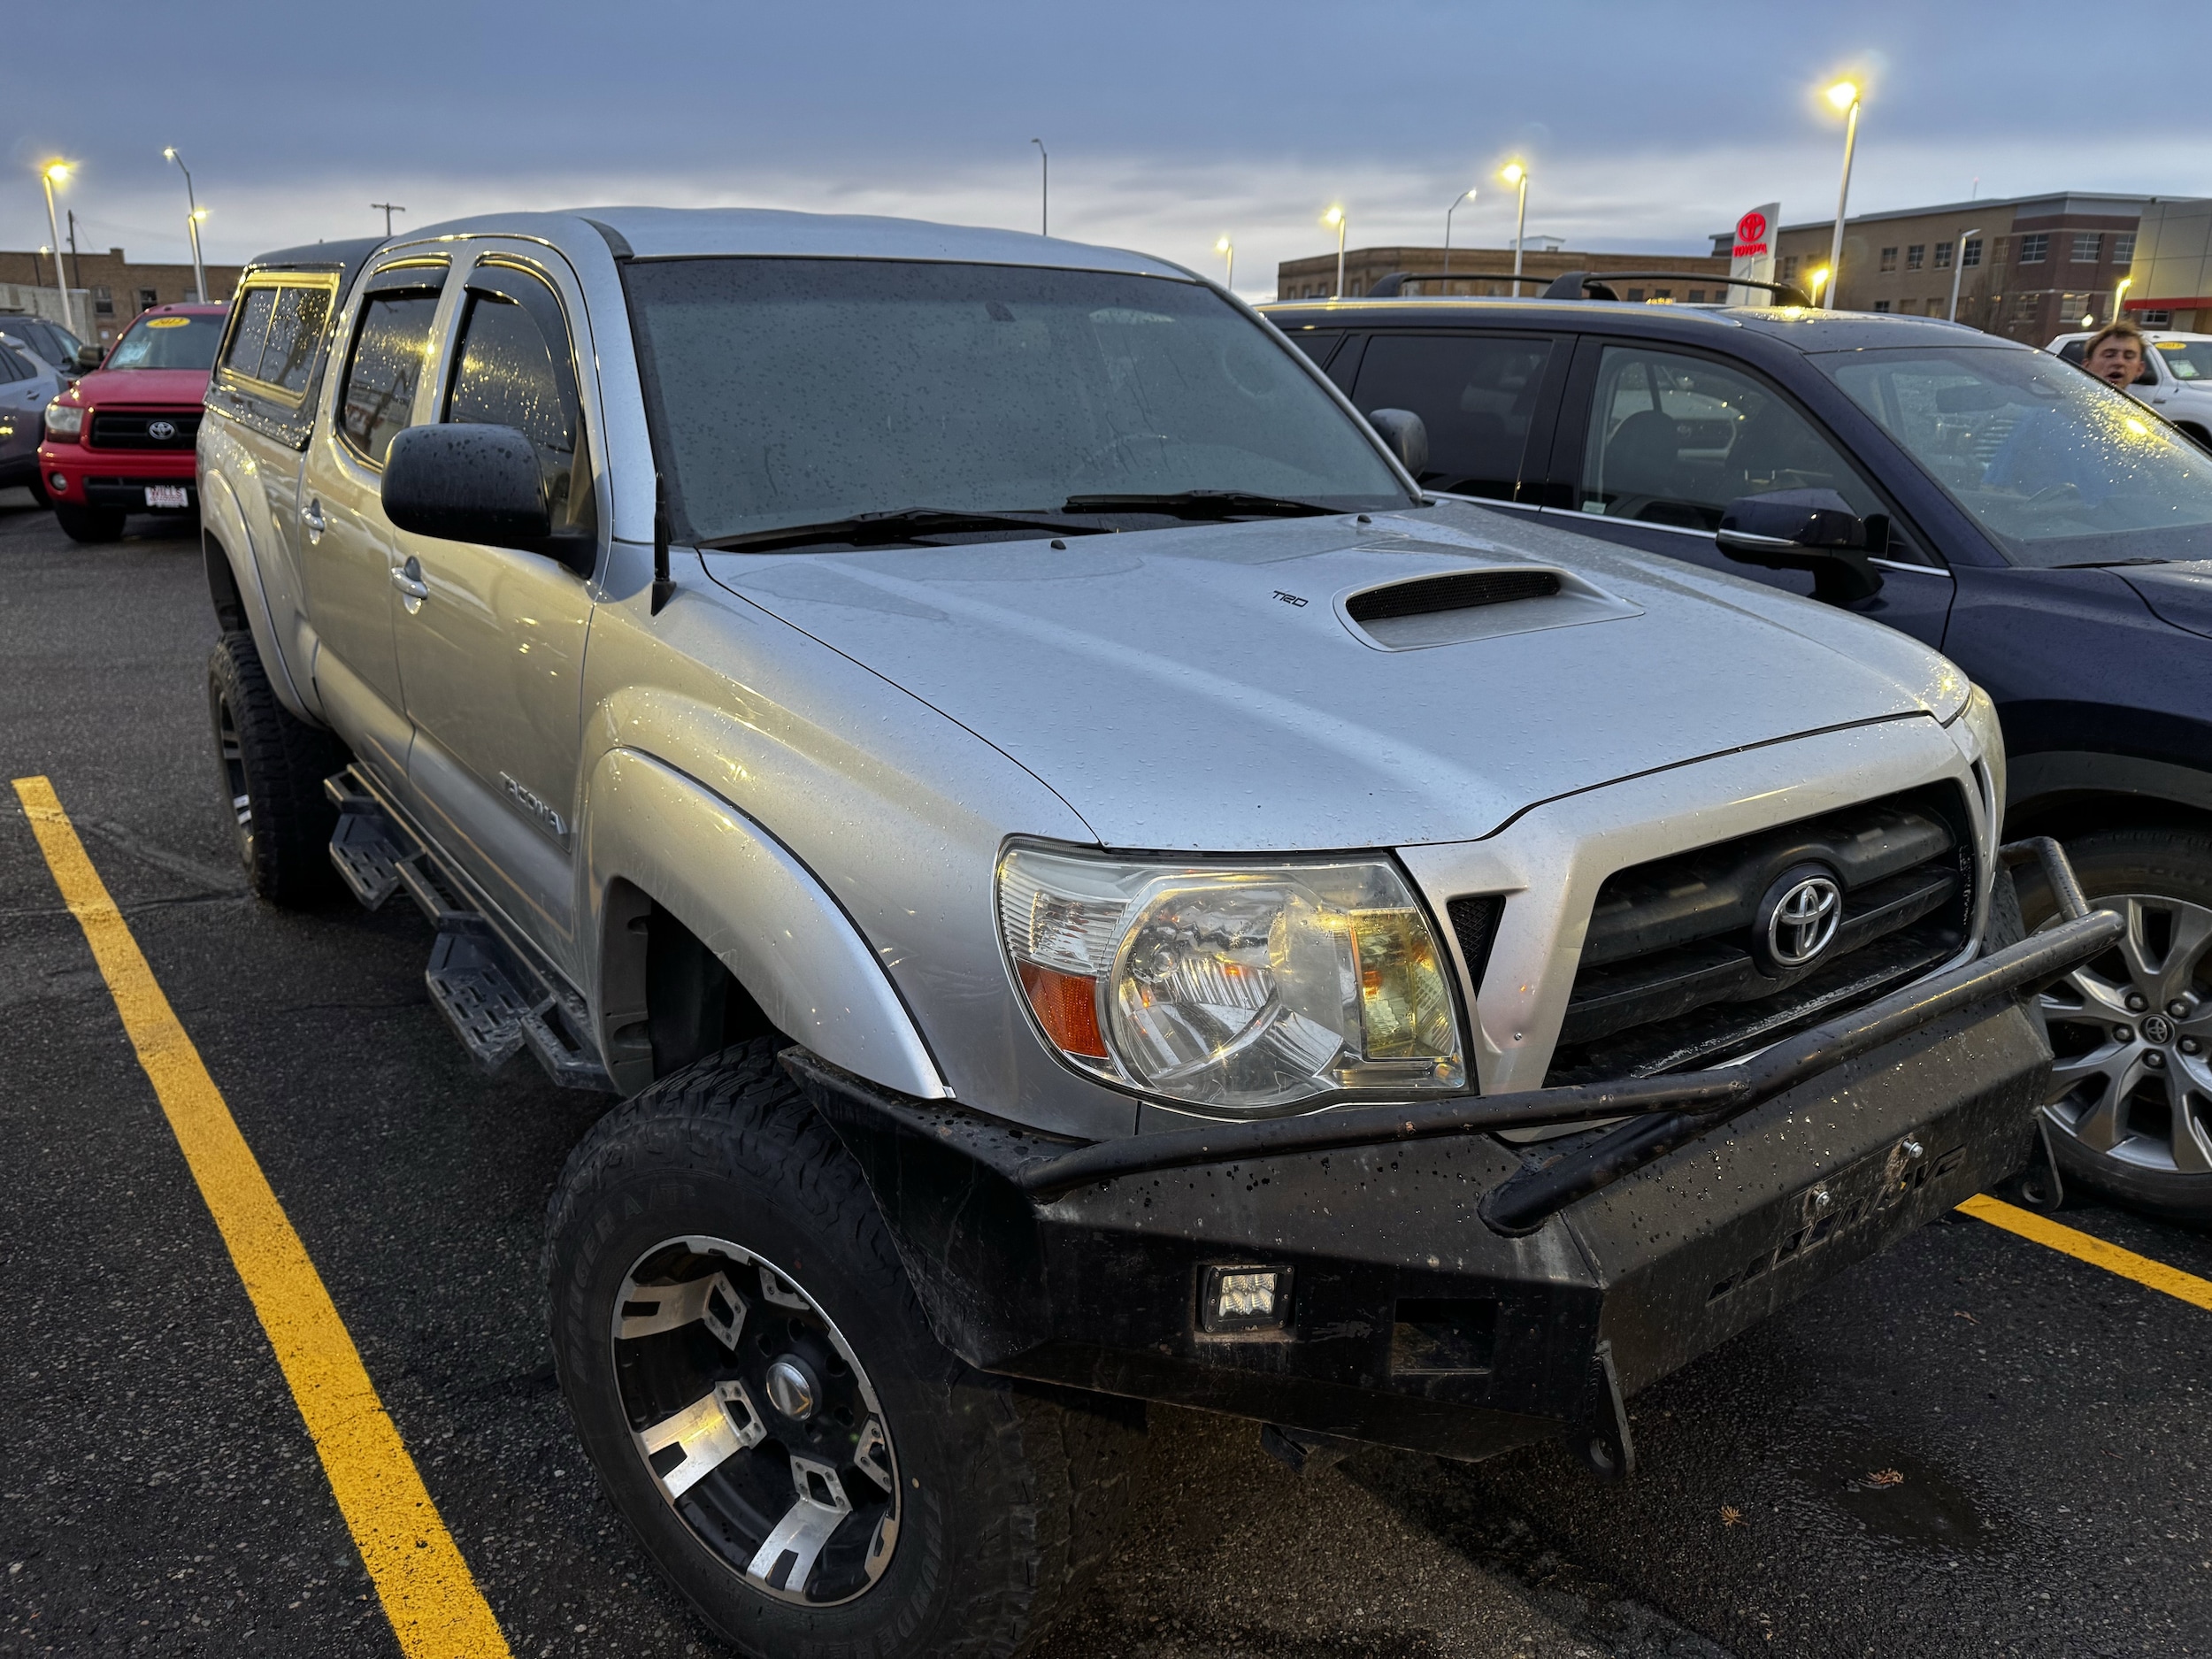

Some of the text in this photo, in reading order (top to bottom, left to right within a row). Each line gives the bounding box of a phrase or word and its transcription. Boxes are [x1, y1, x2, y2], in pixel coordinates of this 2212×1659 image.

[1733, 243, 1767, 257] TOYOTA
[1272, 590, 1309, 607] TRD
[500, 771, 568, 834] TACOMA
